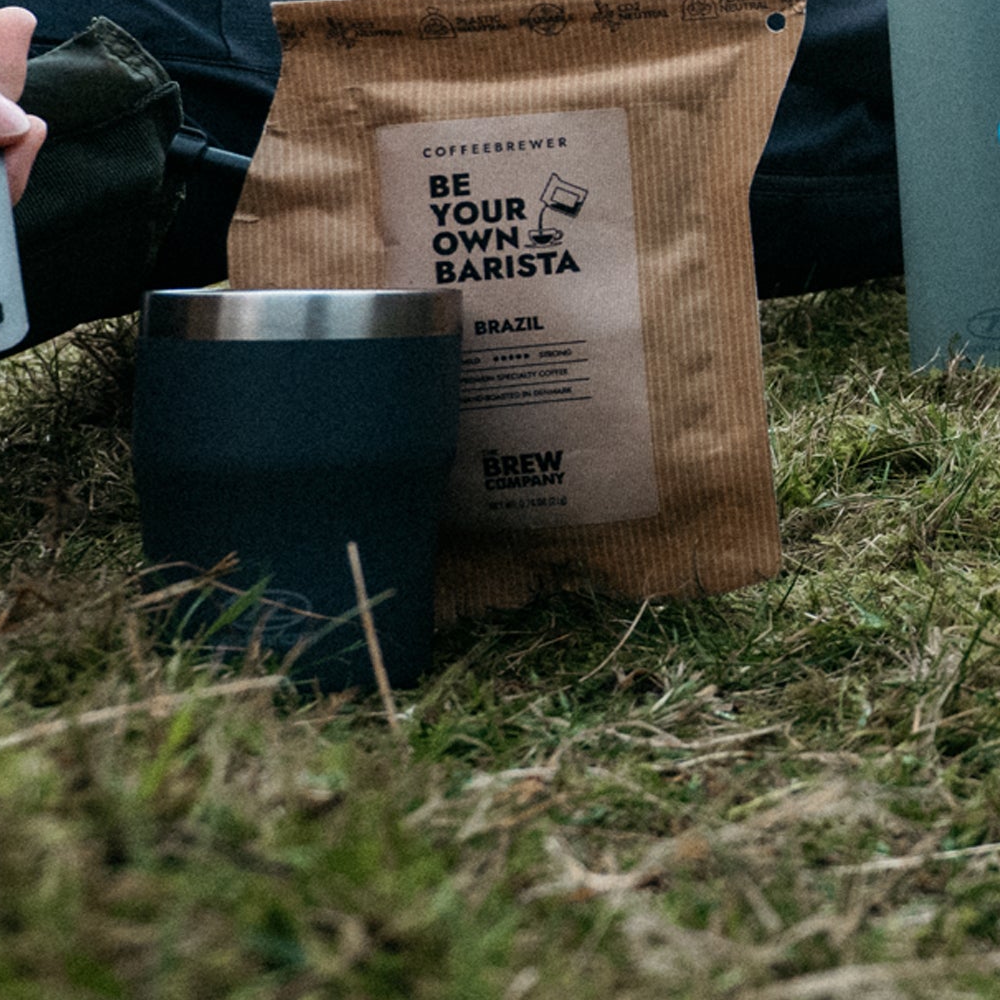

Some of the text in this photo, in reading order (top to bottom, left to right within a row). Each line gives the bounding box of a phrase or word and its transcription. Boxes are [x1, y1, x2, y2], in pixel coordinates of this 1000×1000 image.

[617, 8, 669, 21] NEUTRAL
[719, 0, 769, 13] NEUTRAL
[423, 136, 567, 158] COFFEEBREWER
[429, 173, 471, 198] BE
[429, 197, 527, 226] YOUR
[432, 226, 519, 255] OWN
[435, 249, 581, 284] BARISTA
[474, 316, 544, 336] BRAZIL
[496, 371, 537, 382] SPECIALTY
[538, 368, 568, 378] COFFEE
[482, 449, 564, 477] BREW
[484, 471, 566, 491] COMPANY
